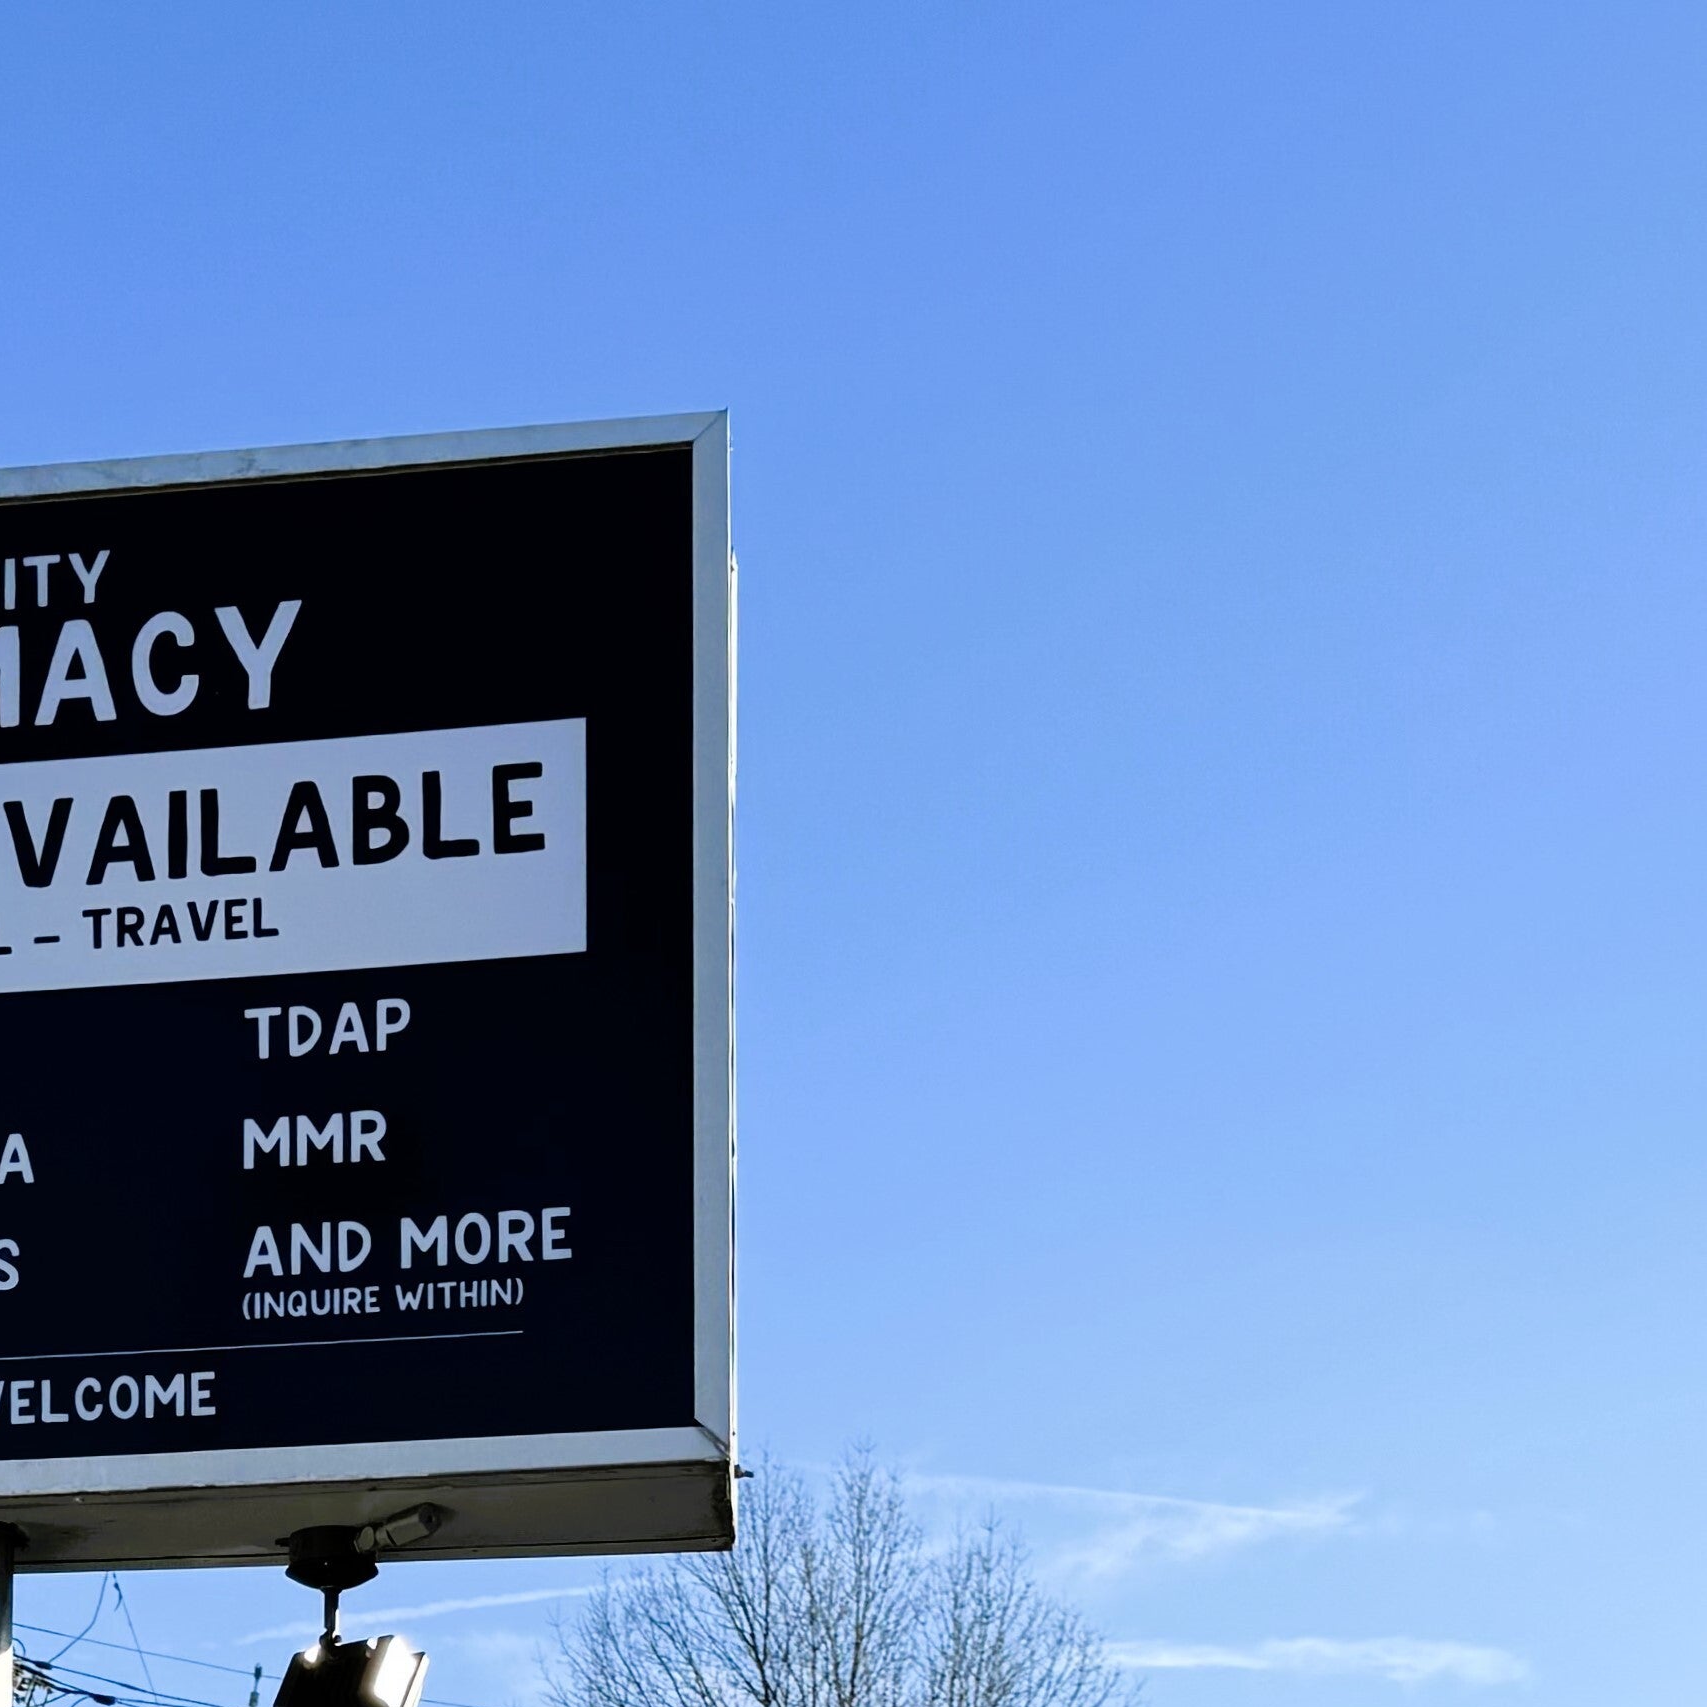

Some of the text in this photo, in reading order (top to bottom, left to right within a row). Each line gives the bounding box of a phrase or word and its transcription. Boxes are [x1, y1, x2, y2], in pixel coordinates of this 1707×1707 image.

[82, 897, 279, 949] TRAVEL
[245, 999, 410, 1059] TDAP
[244, 1110, 386, 1169] MMR
[244, 1207, 571, 1277] AND MORE
[243, 1278, 523, 1319] (INQUIRE WITHIN)
